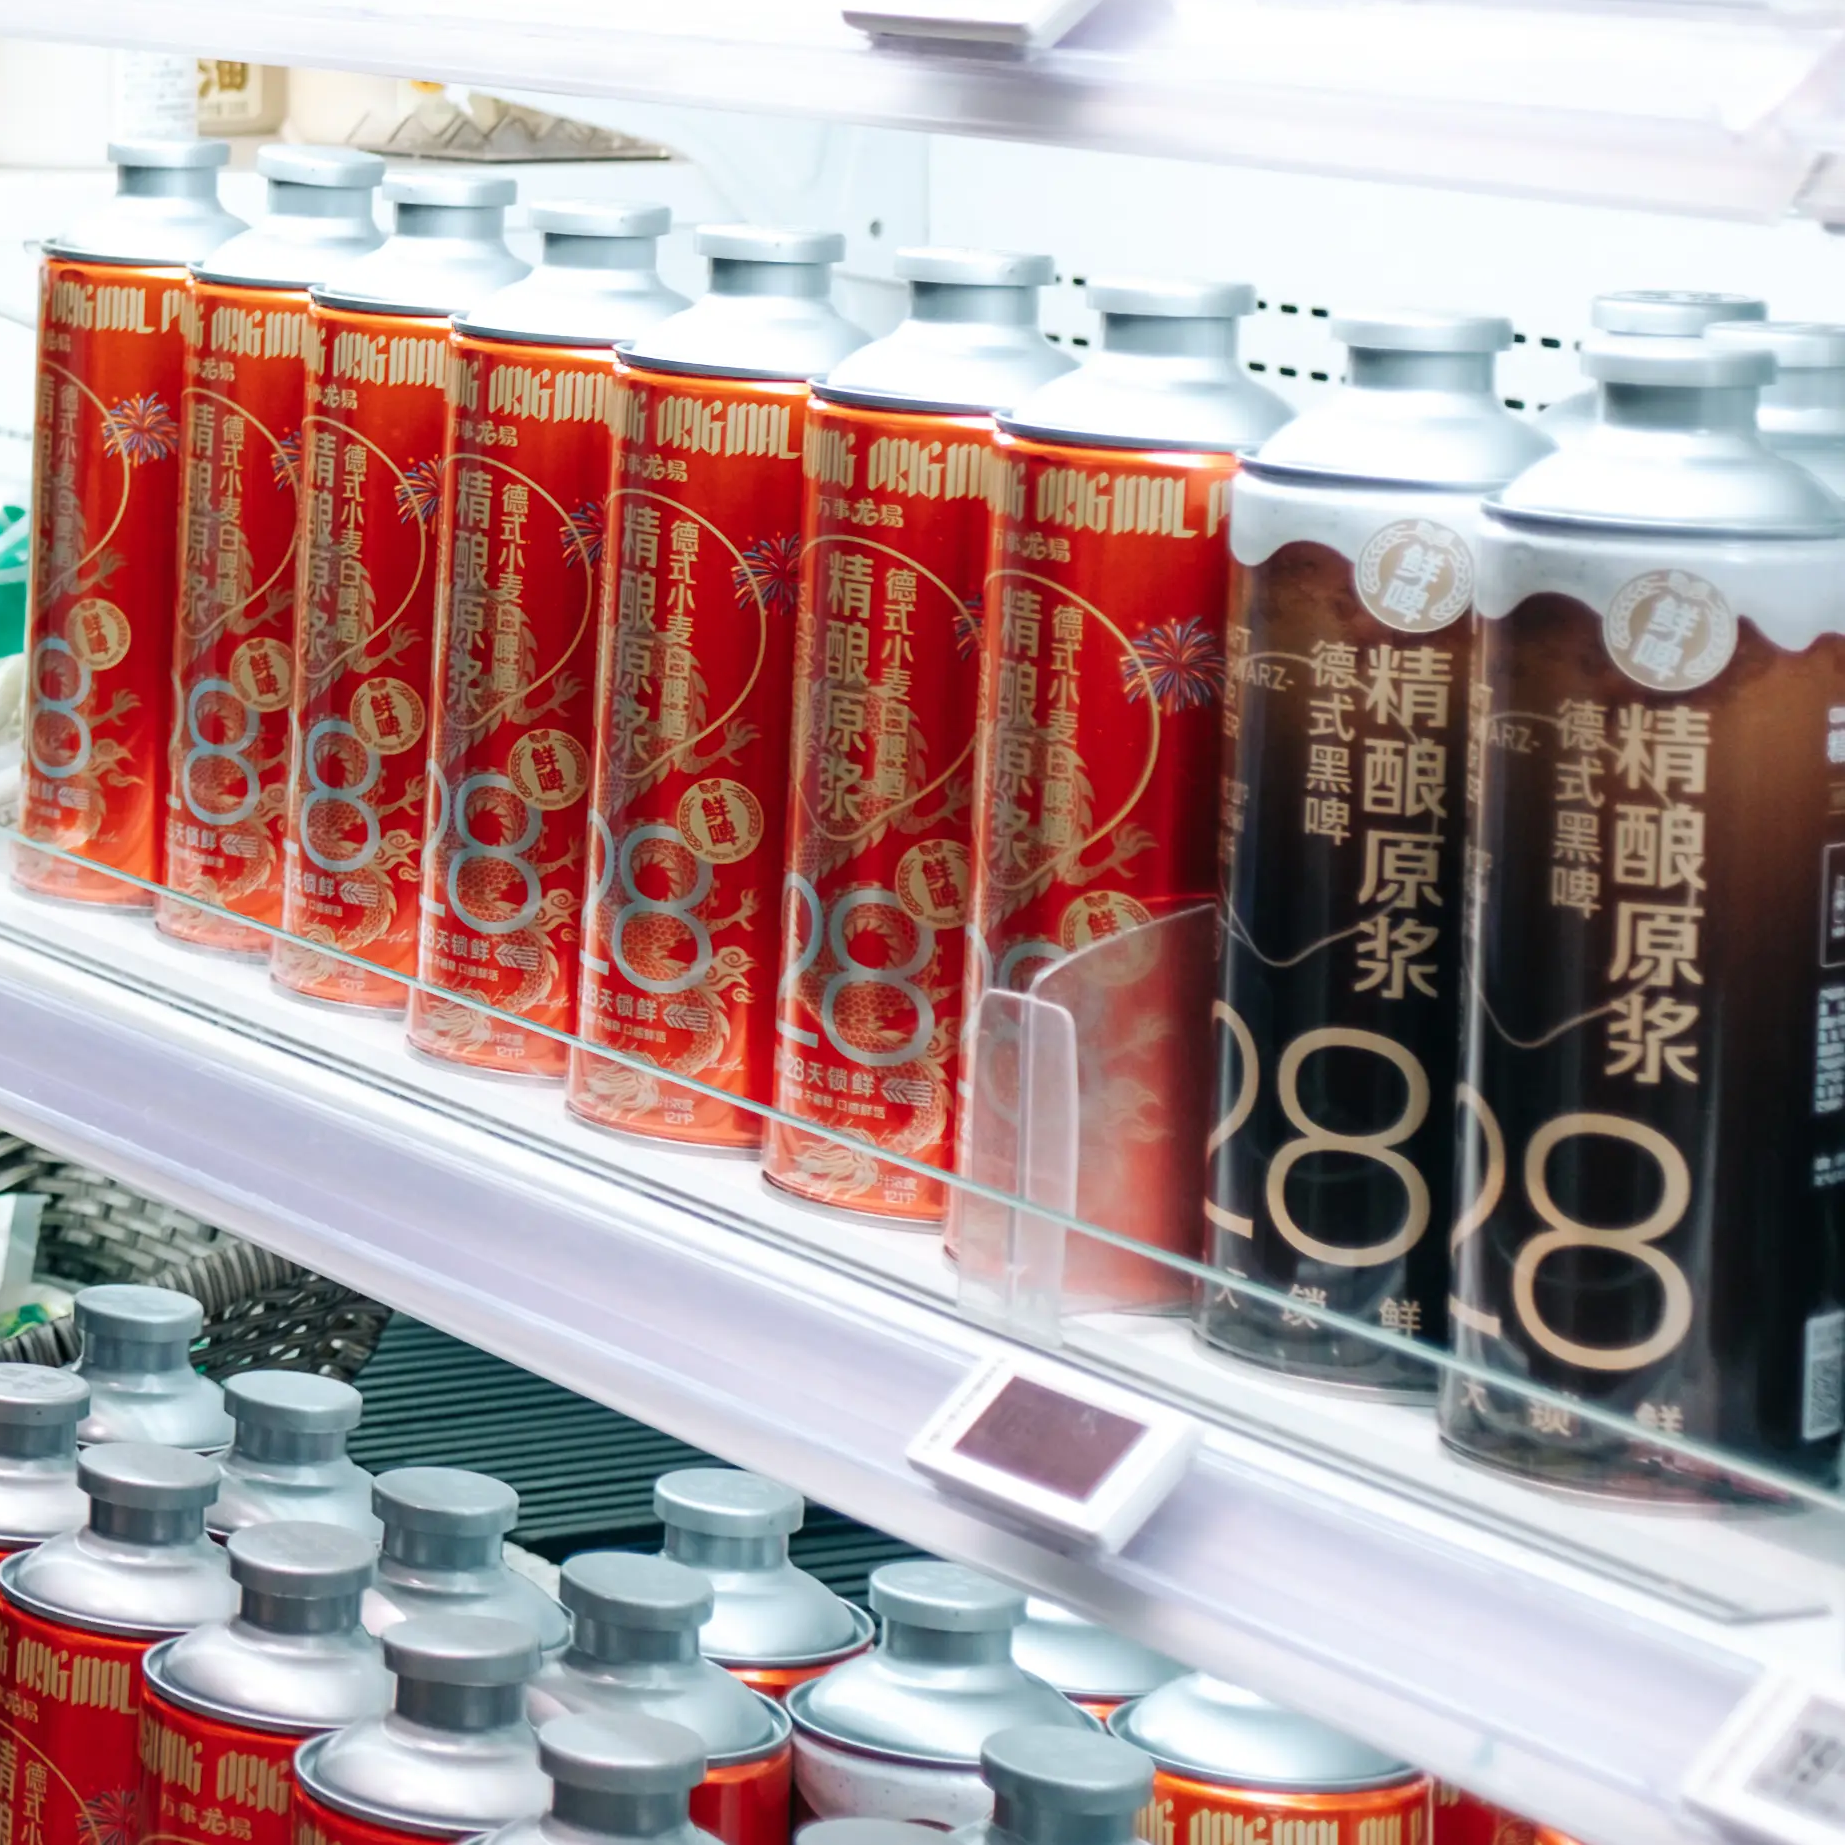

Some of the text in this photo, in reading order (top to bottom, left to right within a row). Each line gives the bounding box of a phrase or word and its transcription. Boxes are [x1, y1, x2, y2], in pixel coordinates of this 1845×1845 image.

[657, 395, 802, 460] ORIGINAL
[1036, 466, 1198, 539] ORIGINAL
[446, 469, 492, 712] 精酿原浆
[613, 504, 661, 760] 精酿原浆
[661, 519, 699, 742] 德式小麦白啤酒
[816, 554, 874, 824] 精酿原浆
[874, 567, 919, 802] 德式小麦白啤酒
[1380, 545, 1446, 627] 鲜啤
[1626, 594, 1703, 681] 鲜啤
[171, 674, 260, 825] 8
[283, 712, 381, 872] 8
[701, 793, 738, 847] 鲜啤
[988, 587, 1042, 876] 精酿原浆
[1304, 640, 1358, 846] 德式黑啤
[1355, 645, 1453, 1001] 精酿原浆
[1550, 698, 1608, 920] 德式黑啤
[1604, 705, 1711, 1086] 精酿原浆
[15, 1637, 139, 1715] ORIGINAL
